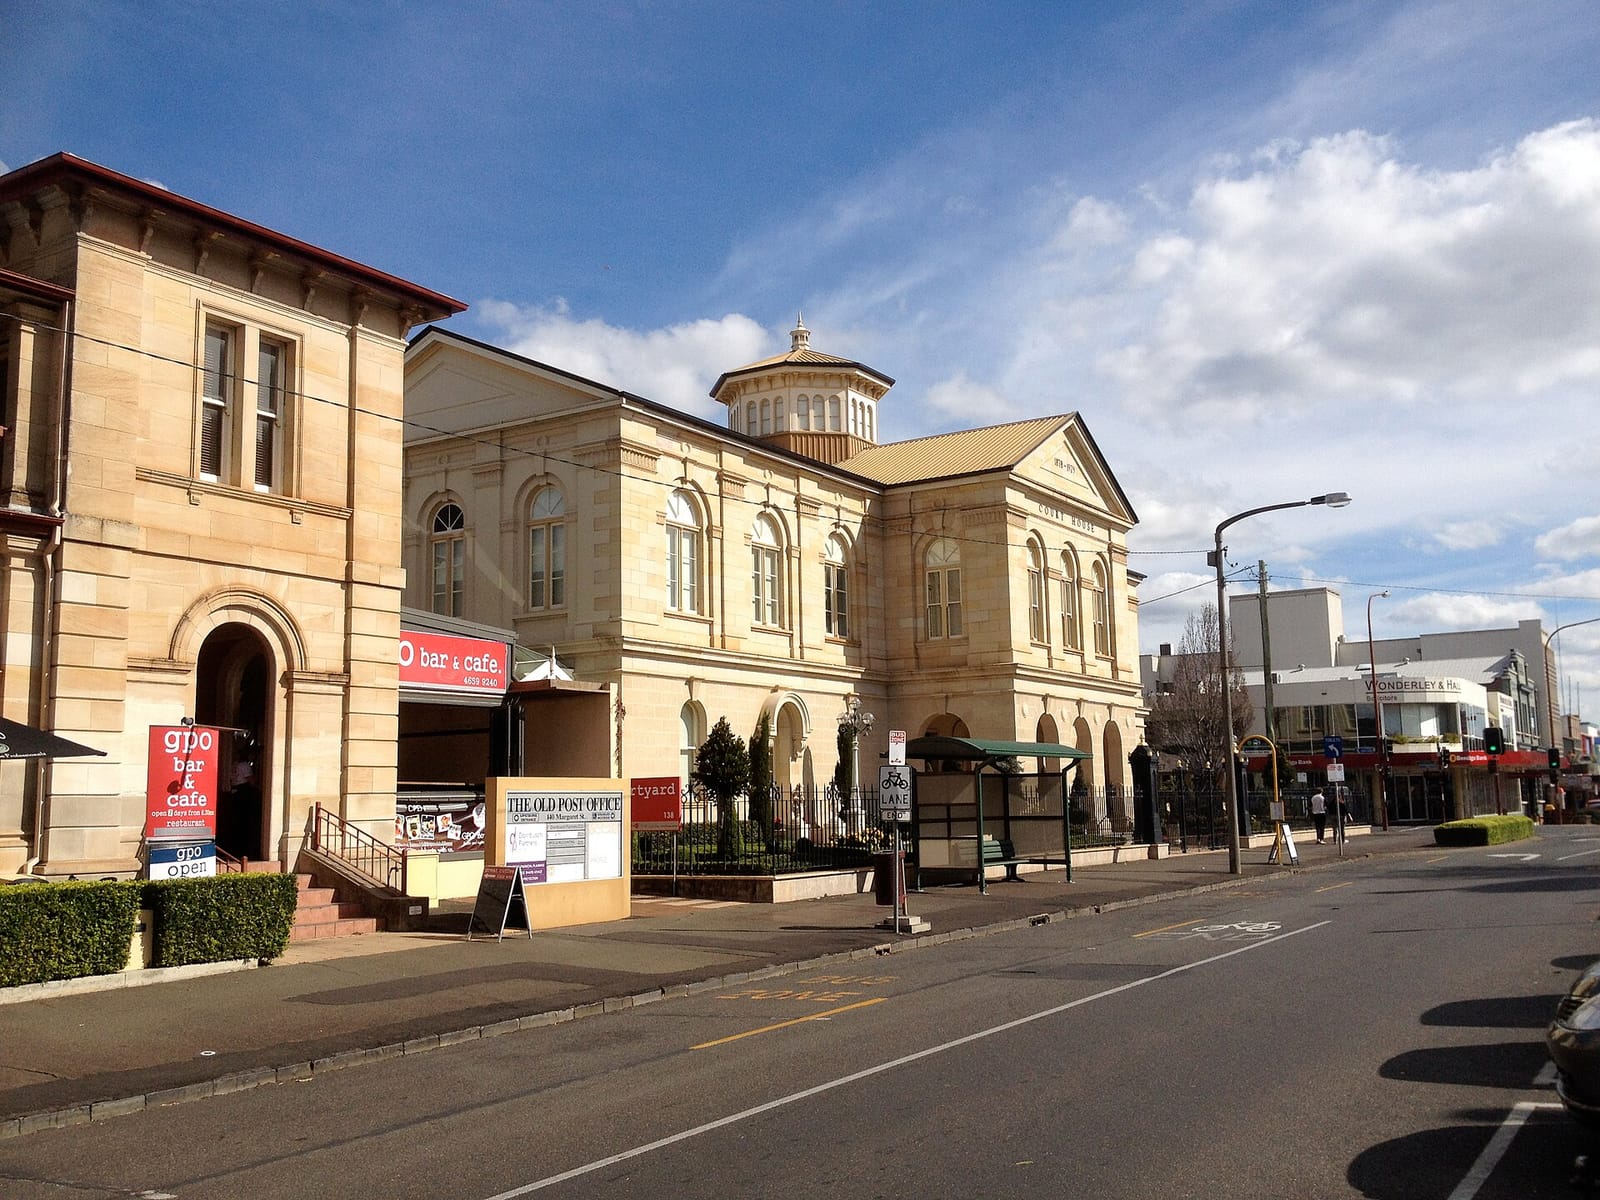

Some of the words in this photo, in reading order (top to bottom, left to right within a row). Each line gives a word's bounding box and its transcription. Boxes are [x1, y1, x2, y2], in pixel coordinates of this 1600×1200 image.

[1038, 504, 1064, 521] COURT
[1071, 516, 1095, 533] HOUSE
[420, 647, 449, 669] bar
[452, 656, 460, 670] &
[1438, 681, 1445, 690] &
[164, 730, 213, 754] gpo
[173, 757, 205, 772] bar
[184, 774, 195, 789] &
[167, 791, 207, 807] cafe
[507, 797, 532, 812] THE
[534, 797, 556, 812] OLD
[559, 797, 585, 812] POST
[586, 796, 621, 811] OFFICE
[881, 794, 909, 805] LANE
[173, 809, 187, 818] days
[886, 811, 904, 819] END
[166, 819, 206, 827] restaurant
[176, 846, 202, 862] gpo
[168, 861, 207, 878] open
